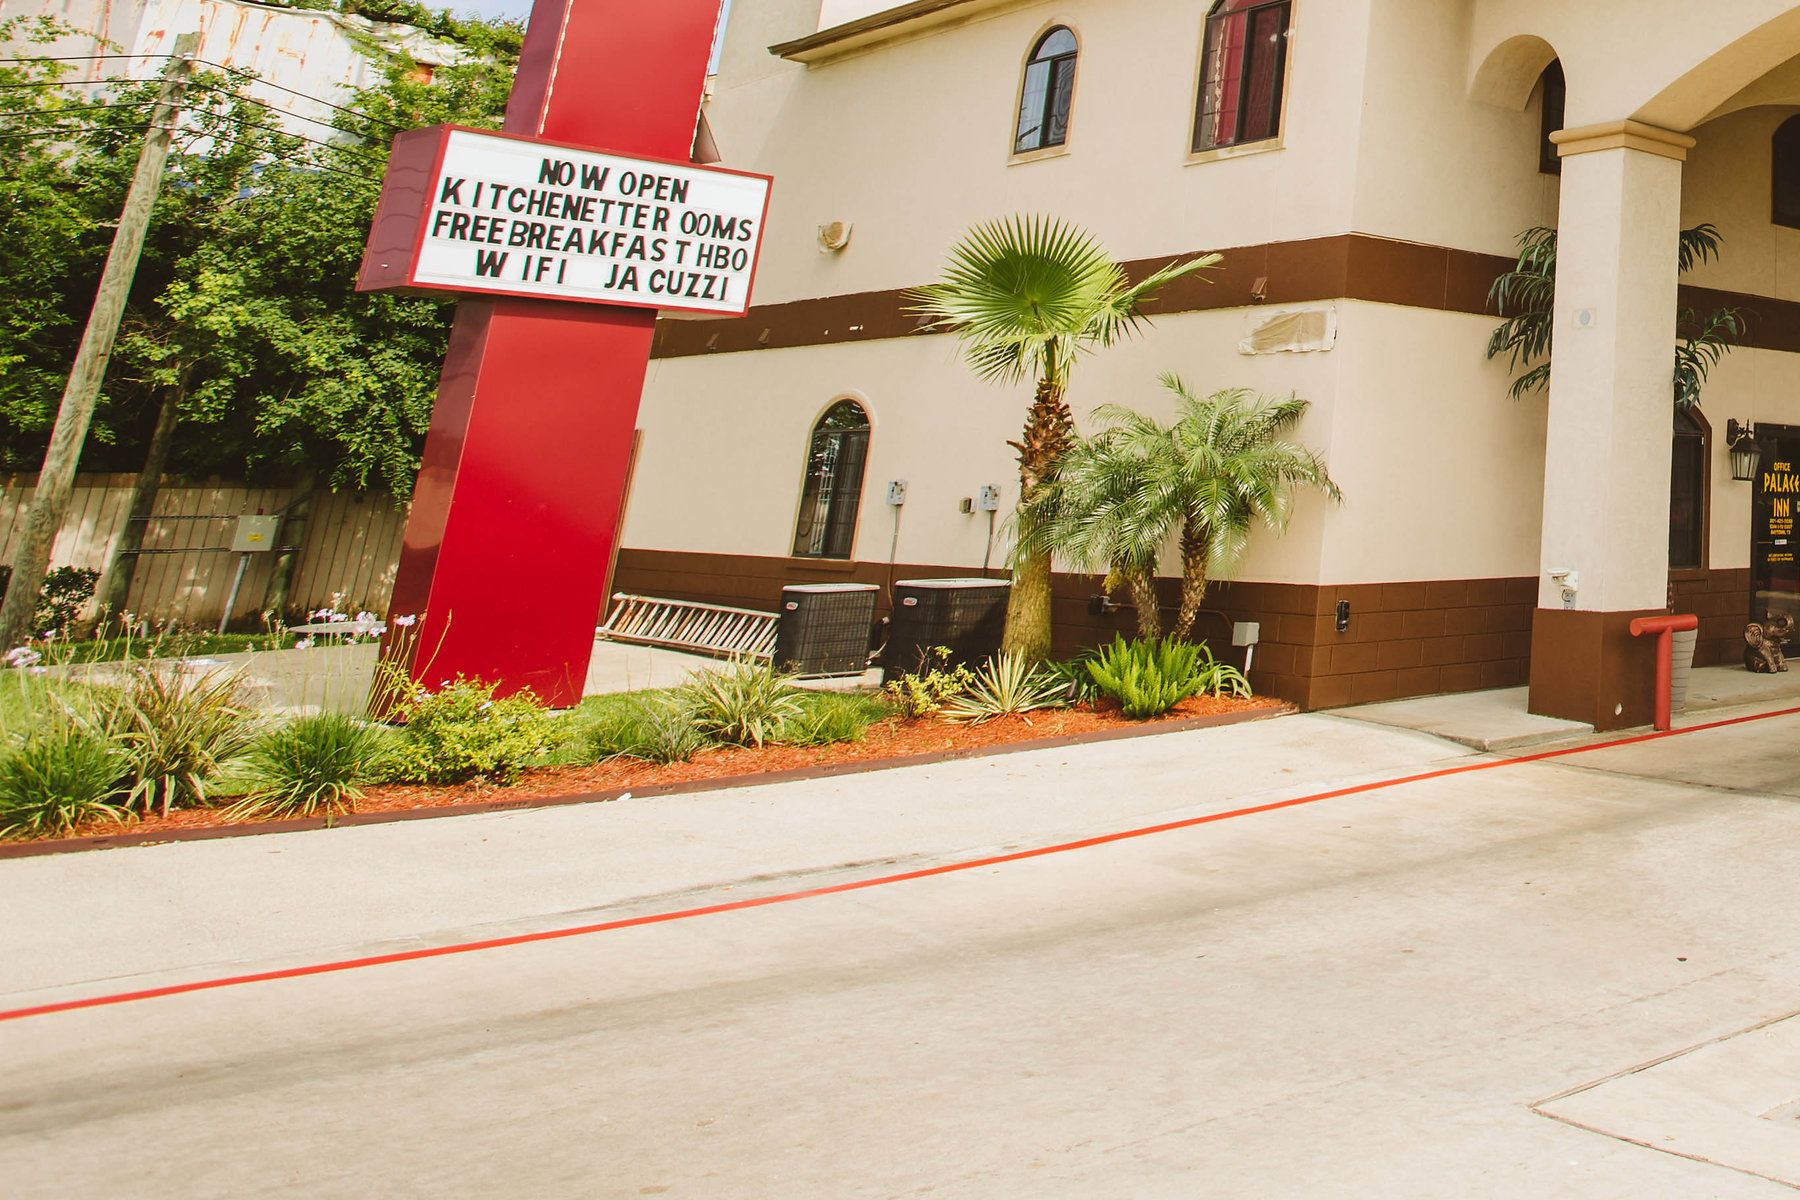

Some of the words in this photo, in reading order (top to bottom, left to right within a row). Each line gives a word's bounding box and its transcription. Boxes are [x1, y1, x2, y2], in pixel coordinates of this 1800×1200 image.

[539, 158, 610, 192] NOW
[618, 171, 690, 204] OPEN
[696, 243, 748, 272] HBO
[1773, 462, 1791, 472] OFFICE
[1763, 472, 1800, 493] PALACE
[1773, 497, 1790, 518] INN
